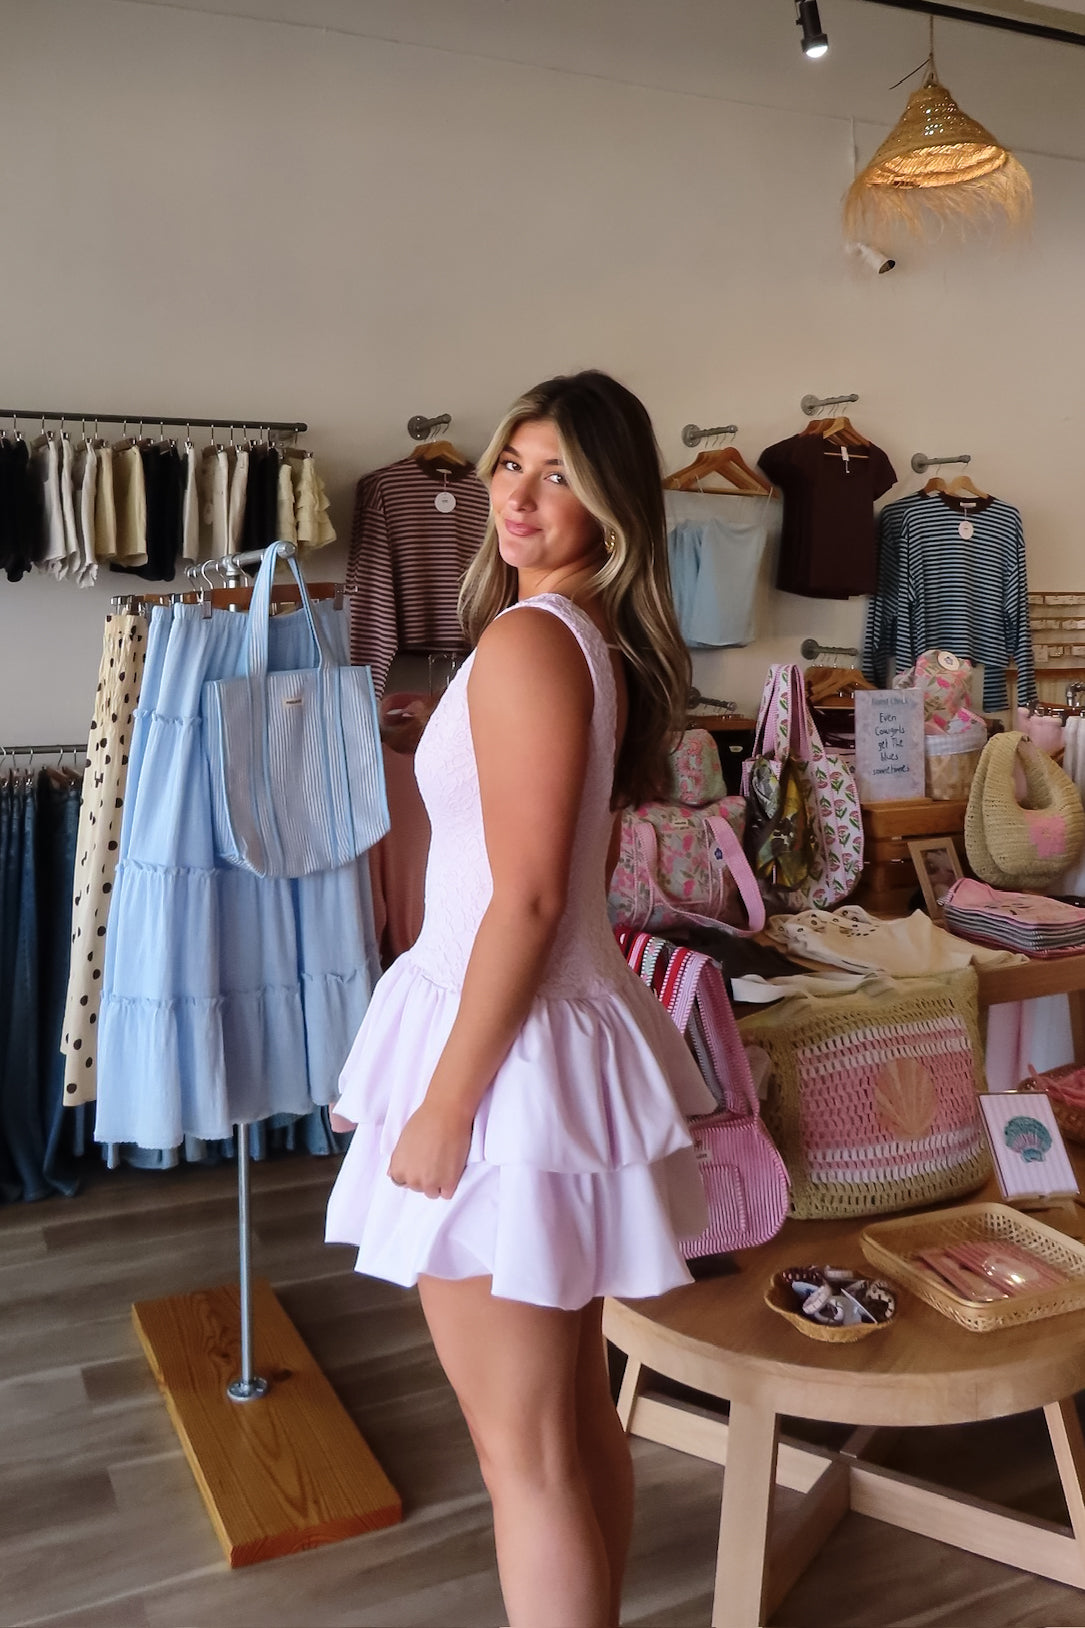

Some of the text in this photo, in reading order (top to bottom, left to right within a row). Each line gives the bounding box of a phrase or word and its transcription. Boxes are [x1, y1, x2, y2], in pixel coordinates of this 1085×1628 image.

[880, 712, 897, 723] Even
[878, 739, 888, 751] get
[880, 752, 899, 761] blues
[872, 764, 910, 776] sometimes
